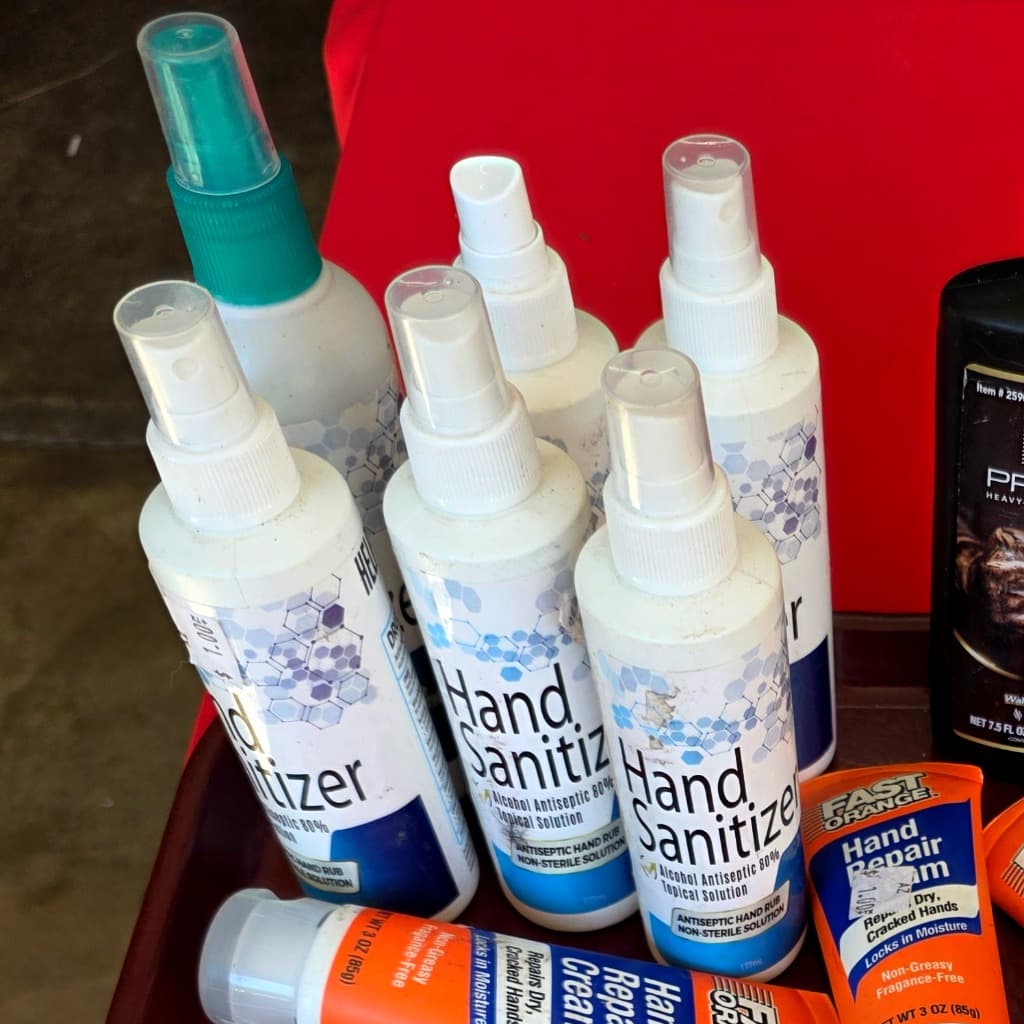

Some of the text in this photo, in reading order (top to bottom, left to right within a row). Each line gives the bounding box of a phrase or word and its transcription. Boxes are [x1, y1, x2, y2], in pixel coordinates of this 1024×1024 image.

[976, 382, 996, 397] Item
[435, 659, 574, 736] Hand
[970, 715, 986, 728] NET
[988, 721, 1002, 732] 7.5
[1003, 723, 1014, 734] FL
[459, 724, 609, 791] Sanitiz
[619, 736, 748, 814] Hand
[820, 772, 927, 822] FAST
[823, 790, 932, 831] ORANGE
[300, 817, 330, 834] 80%
[842, 817, 919, 863] Hand
[659, 851, 780, 887] Alcohol Antiseptic 80%
[846, 835, 943, 889] Repair
[662, 880, 748, 902] Topical Solution
[677, 895, 781, 927] ANTISEPTIC HAND RUB
[678, 904, 785, 938] NON-STERILE SOLUTION
[866, 901, 959, 943] Cracked Hands
[391, 924, 438, 988] Fragance-Free
[412, 931, 455, 985] Non-Greasy
[474, 935, 492, 959] Locks
[475, 960, 492, 968] in
[506, 945, 524, 986] Cracked
[864, 921, 968, 969] Locks in Moisture
[524, 950, 546, 1017] Repairs Dry,
[876, 973, 965, 999] Fragance-Free
[881, 960, 953, 982] Non-Greasy
